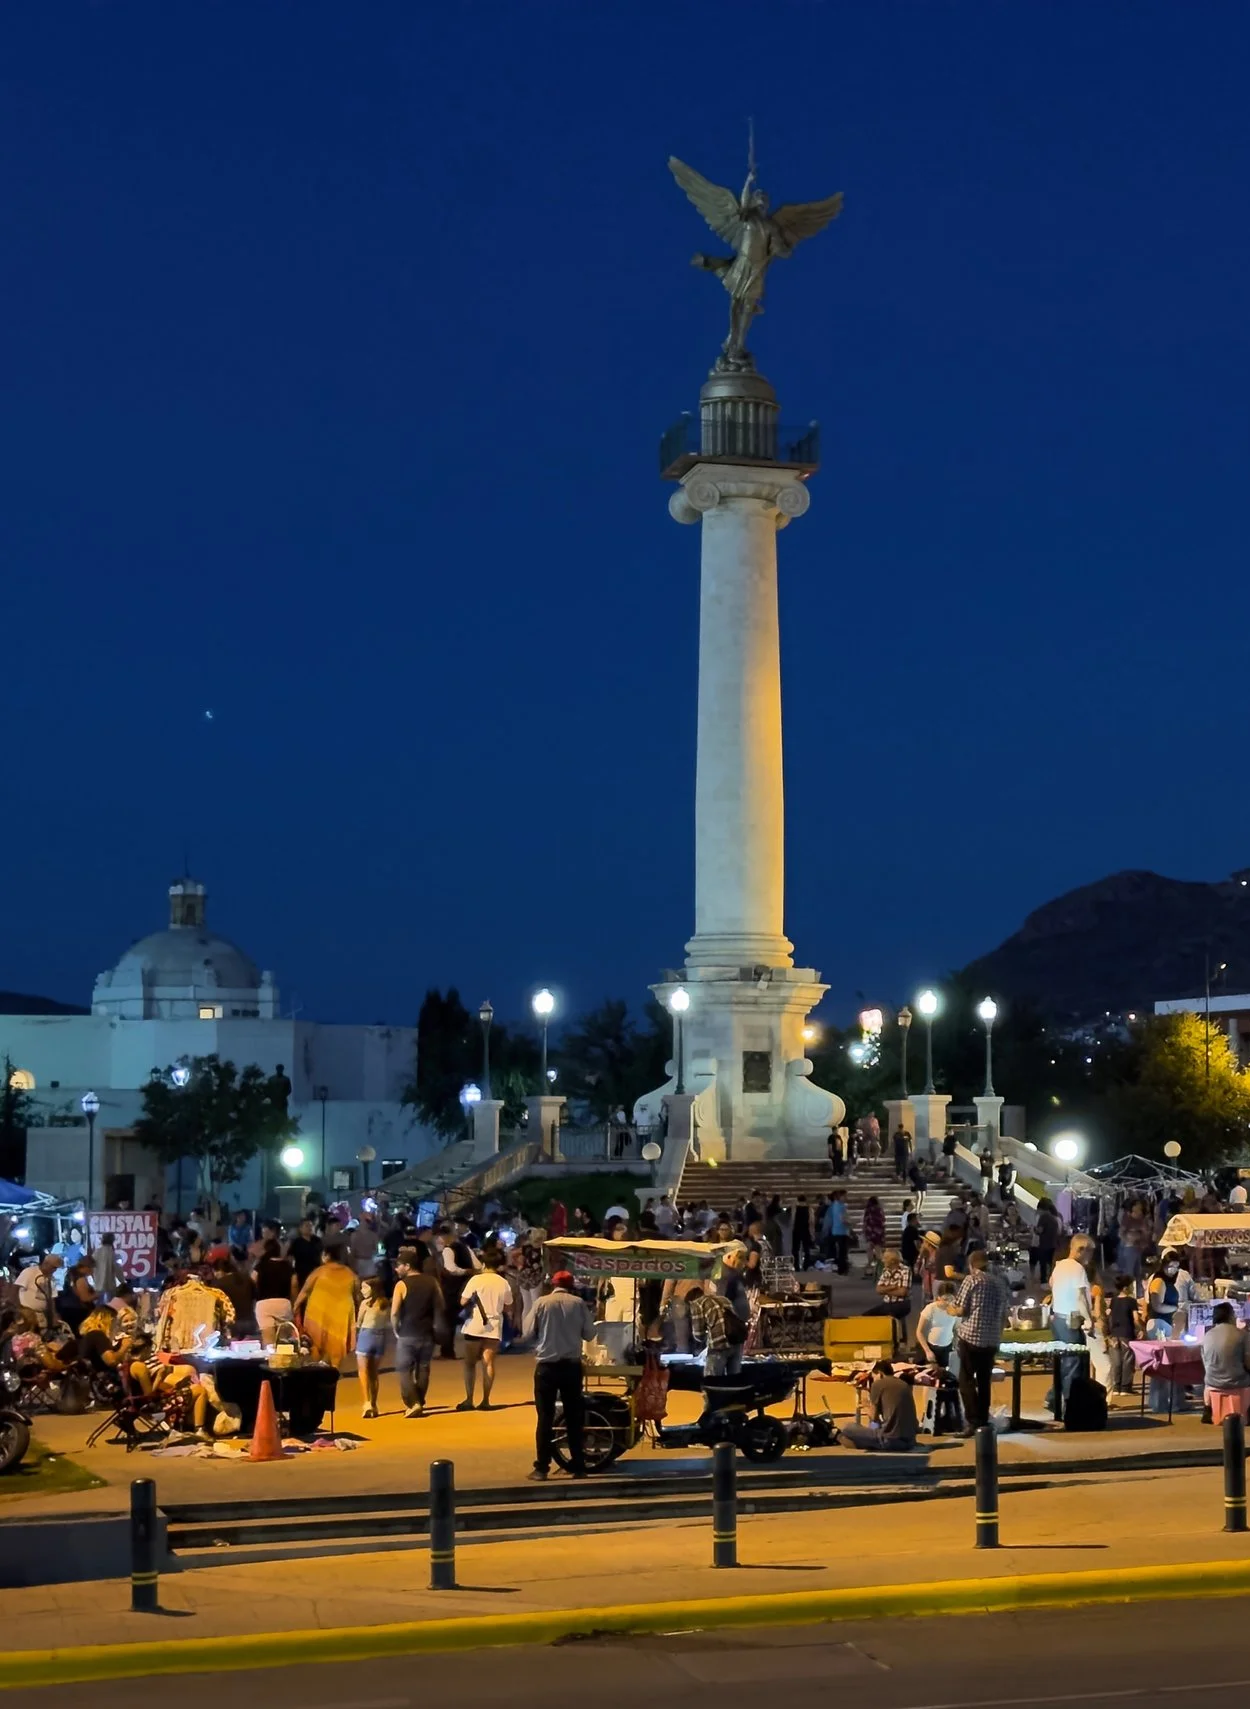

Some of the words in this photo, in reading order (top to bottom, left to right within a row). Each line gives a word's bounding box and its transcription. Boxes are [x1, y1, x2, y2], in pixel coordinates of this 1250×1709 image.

[90, 1215, 153, 1233] CRISTAL
[90, 1233, 154, 1249] TEPLADO
[1204, 1230, 1250, 1245] RASPADOS
[574, 1251, 686, 1273] Raspados
